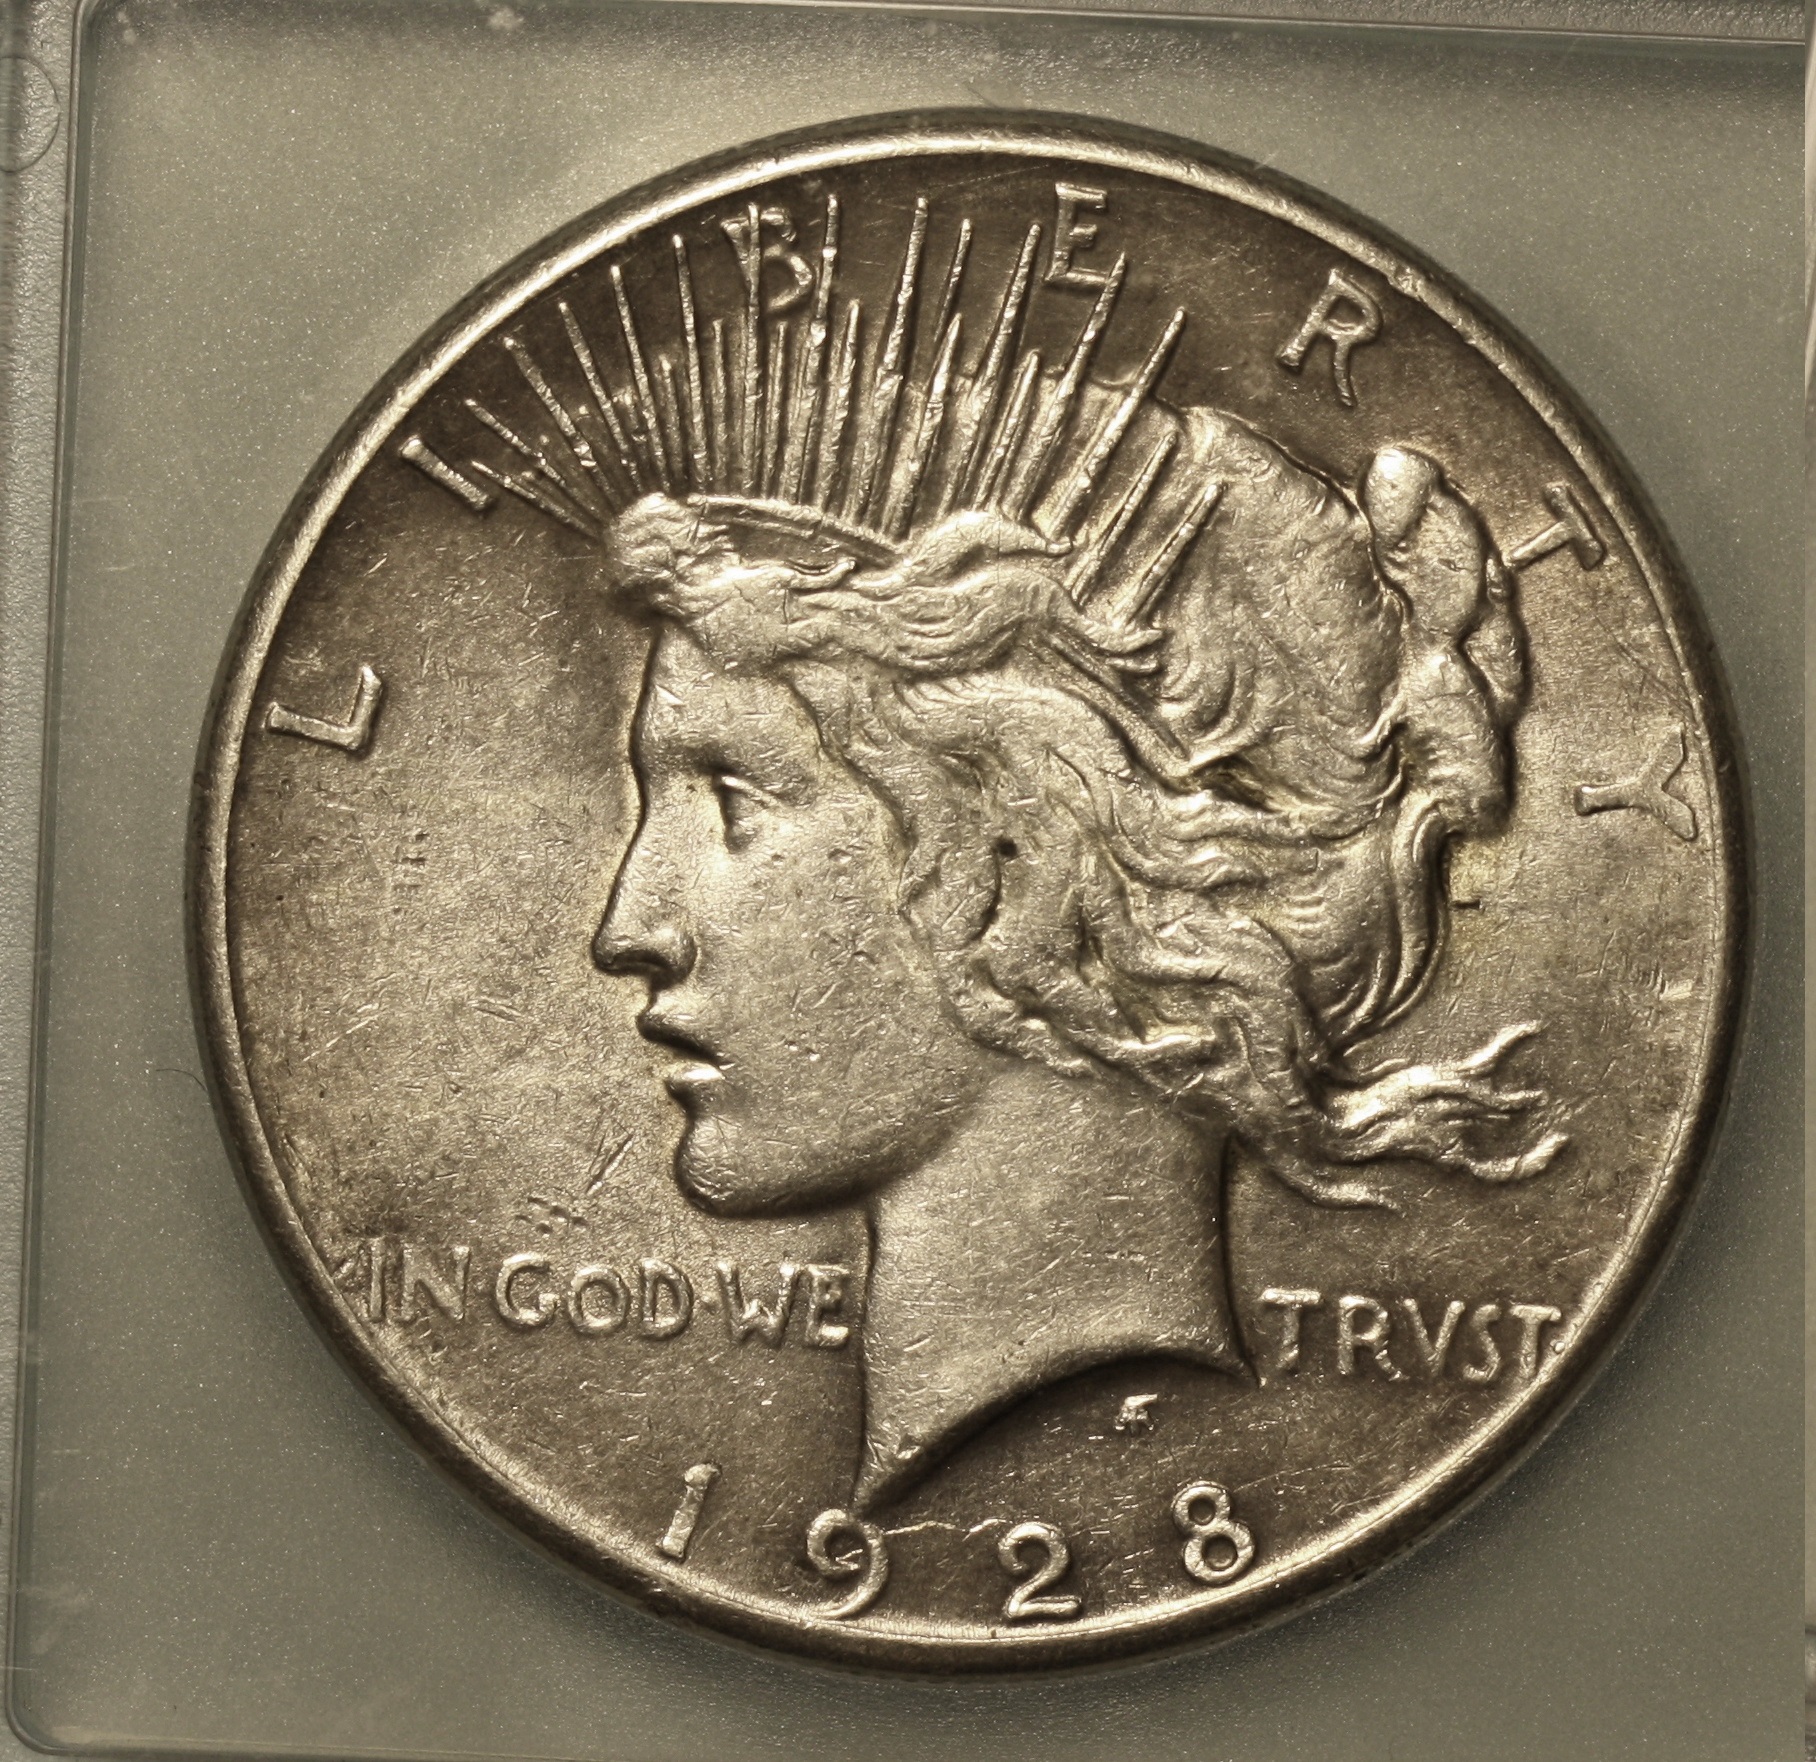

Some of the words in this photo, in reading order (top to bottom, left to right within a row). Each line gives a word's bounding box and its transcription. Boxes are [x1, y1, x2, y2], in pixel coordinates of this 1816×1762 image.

[266, 181, 1698, 842] LIBERTY
[357, 1236, 472, 1323] IN
[497, 1252, 695, 1340] GOD
[717, 1261, 855, 1350] WE
[655, 1460, 1256, 1620] 1928
